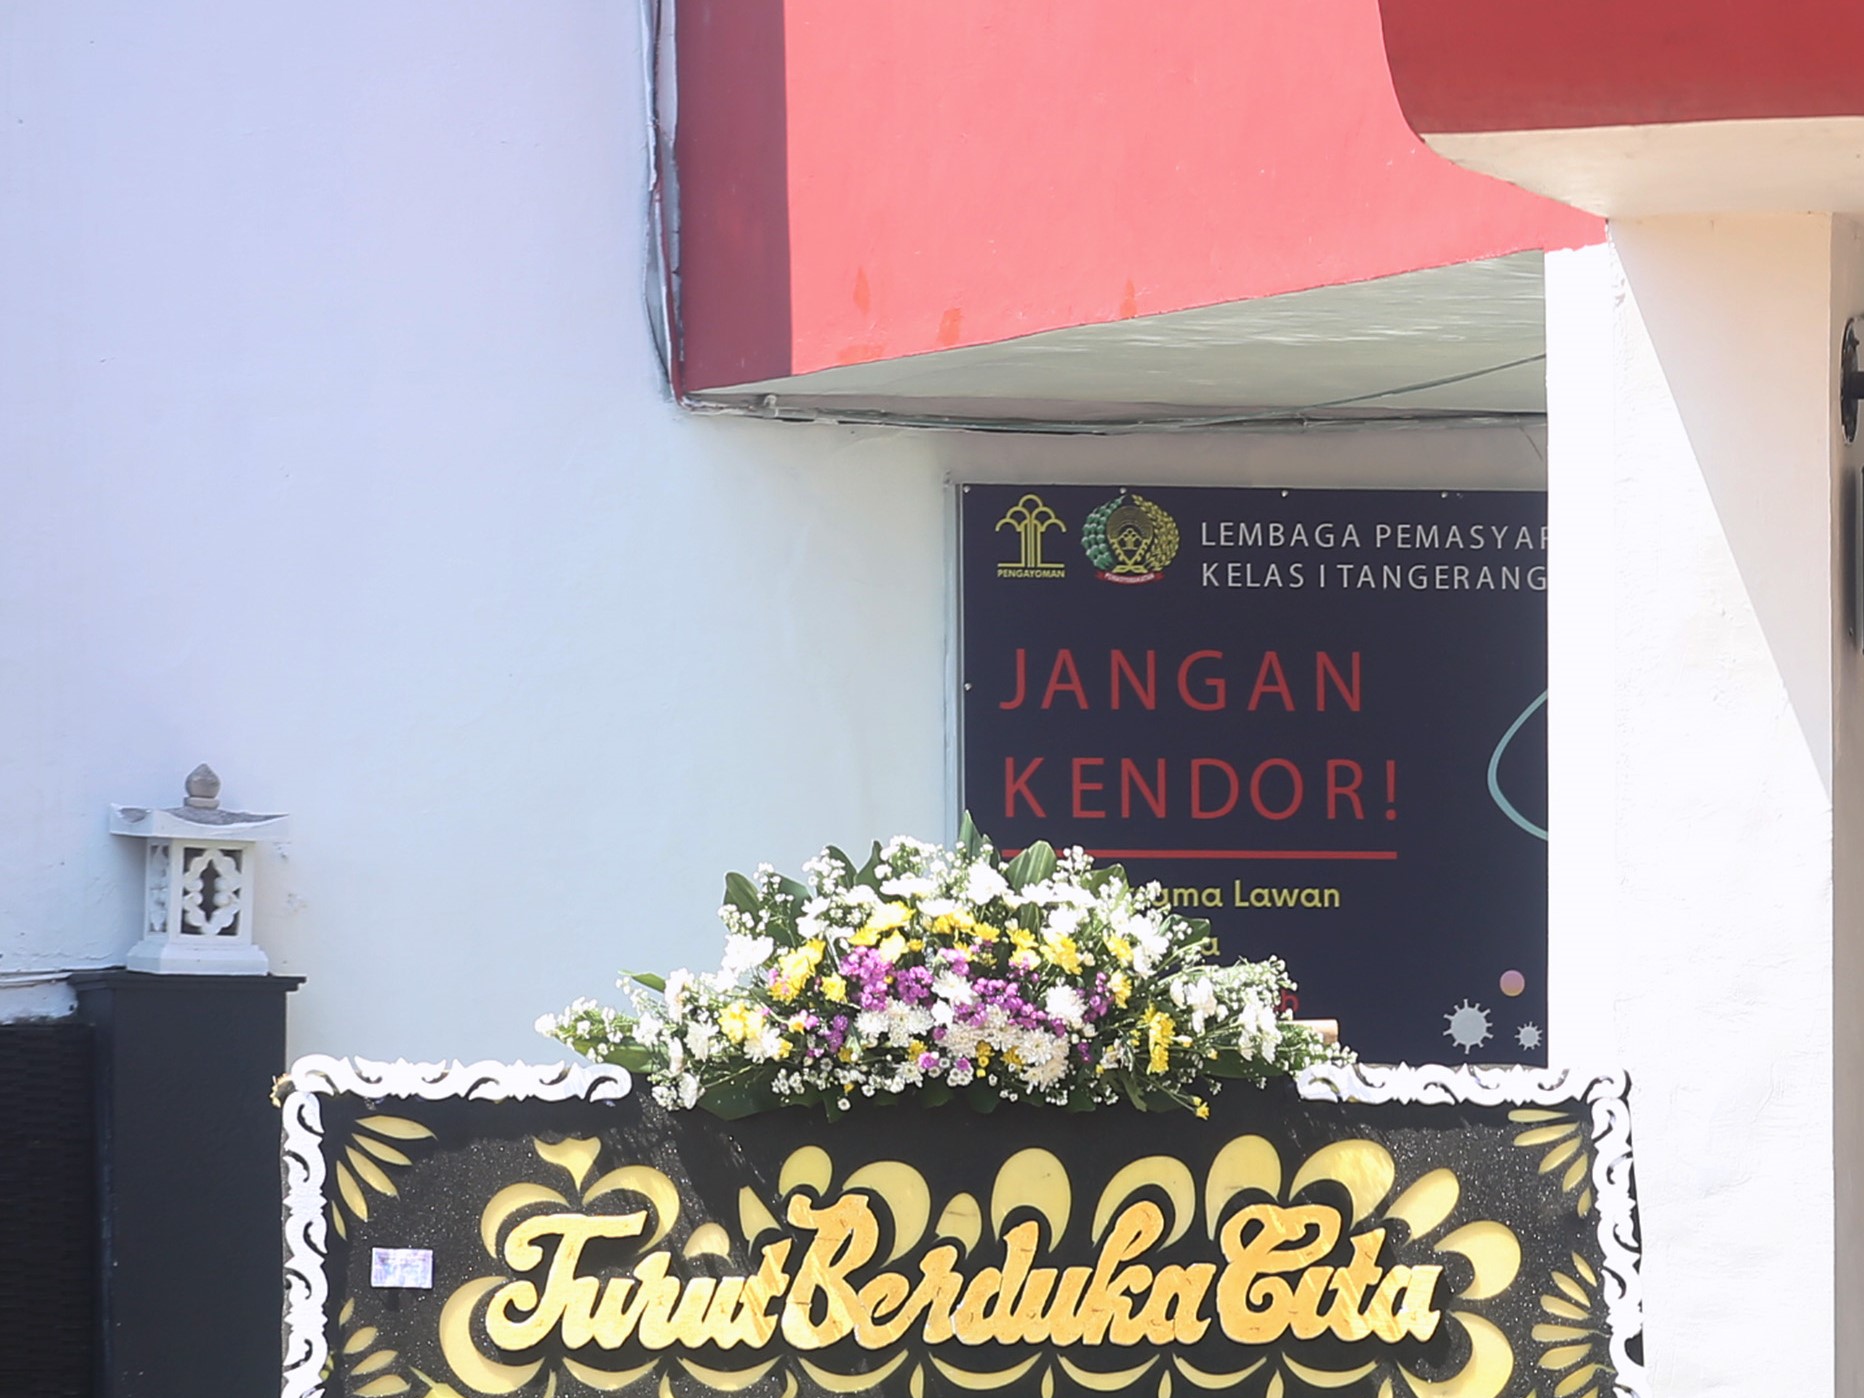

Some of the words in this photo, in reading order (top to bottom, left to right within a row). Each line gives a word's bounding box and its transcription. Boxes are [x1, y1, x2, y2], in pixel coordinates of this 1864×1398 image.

[1201, 522, 1361, 548] LEMBAGA
[997, 569, 1065, 578] PENGAYOMAN
[1202, 562, 1304, 588] KELAS
[1320, 564, 1325, 588] I
[1336, 564, 1547, 590] TANGERANG
[1000, 648, 1362, 712] JANGAN
[1005, 756, 1397, 820] KENDOR!
[1234, 880, 1341, 908] Lawan
[486, 1210, 793, 1350] Turut
[782, 1195, 1217, 1350] Berduka
[1216, 1202, 1443, 1343] Cita
